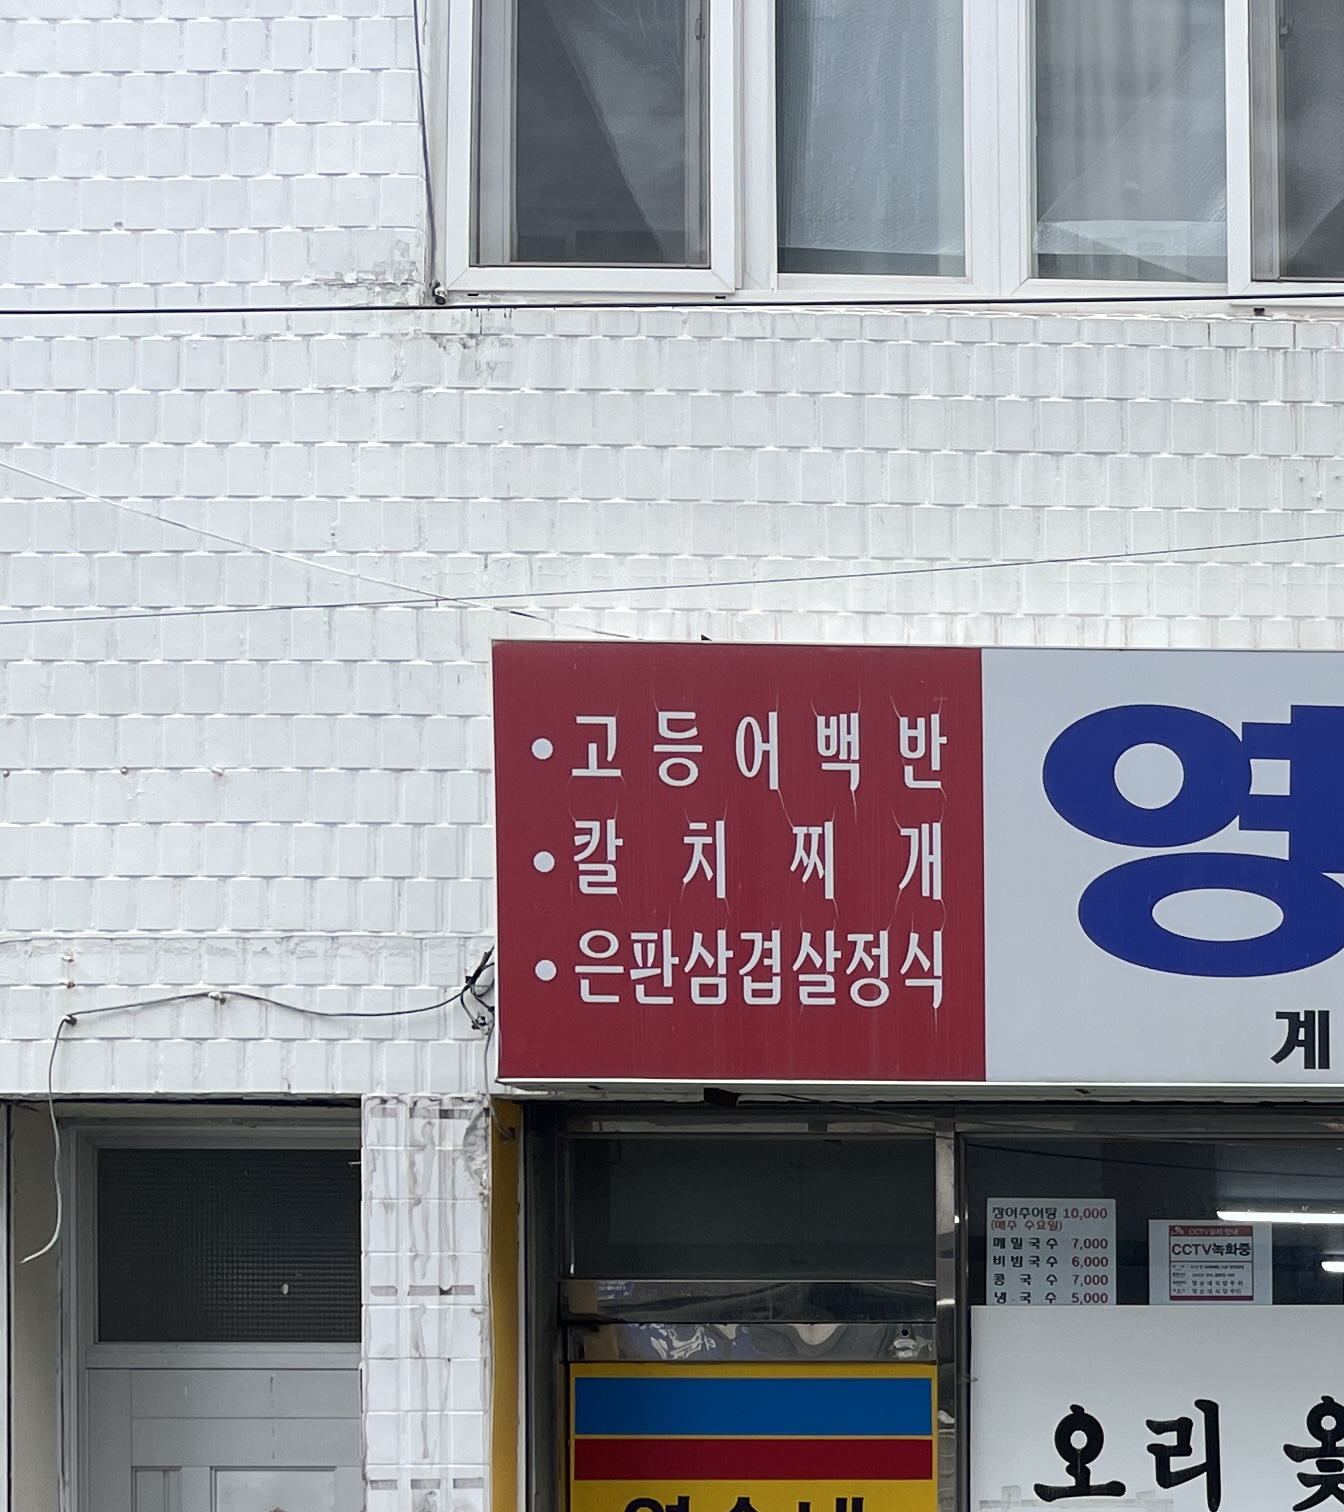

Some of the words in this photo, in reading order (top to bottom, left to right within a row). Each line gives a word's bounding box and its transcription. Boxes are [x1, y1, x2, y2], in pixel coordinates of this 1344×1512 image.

[573, 929, 945, 1010] 은판삼겹살정식
[1063, 1207, 1108, 1221] 10,000
[1072, 1238, 1108, 1250] 7,000
[1072, 1256, 1109, 1269] 6,000
[1072, 1274, 1109, 1287] 7,000
[1072, 1292, 1108, 1305] 5,000
[1033, 1399, 1222, 1512] 오리
